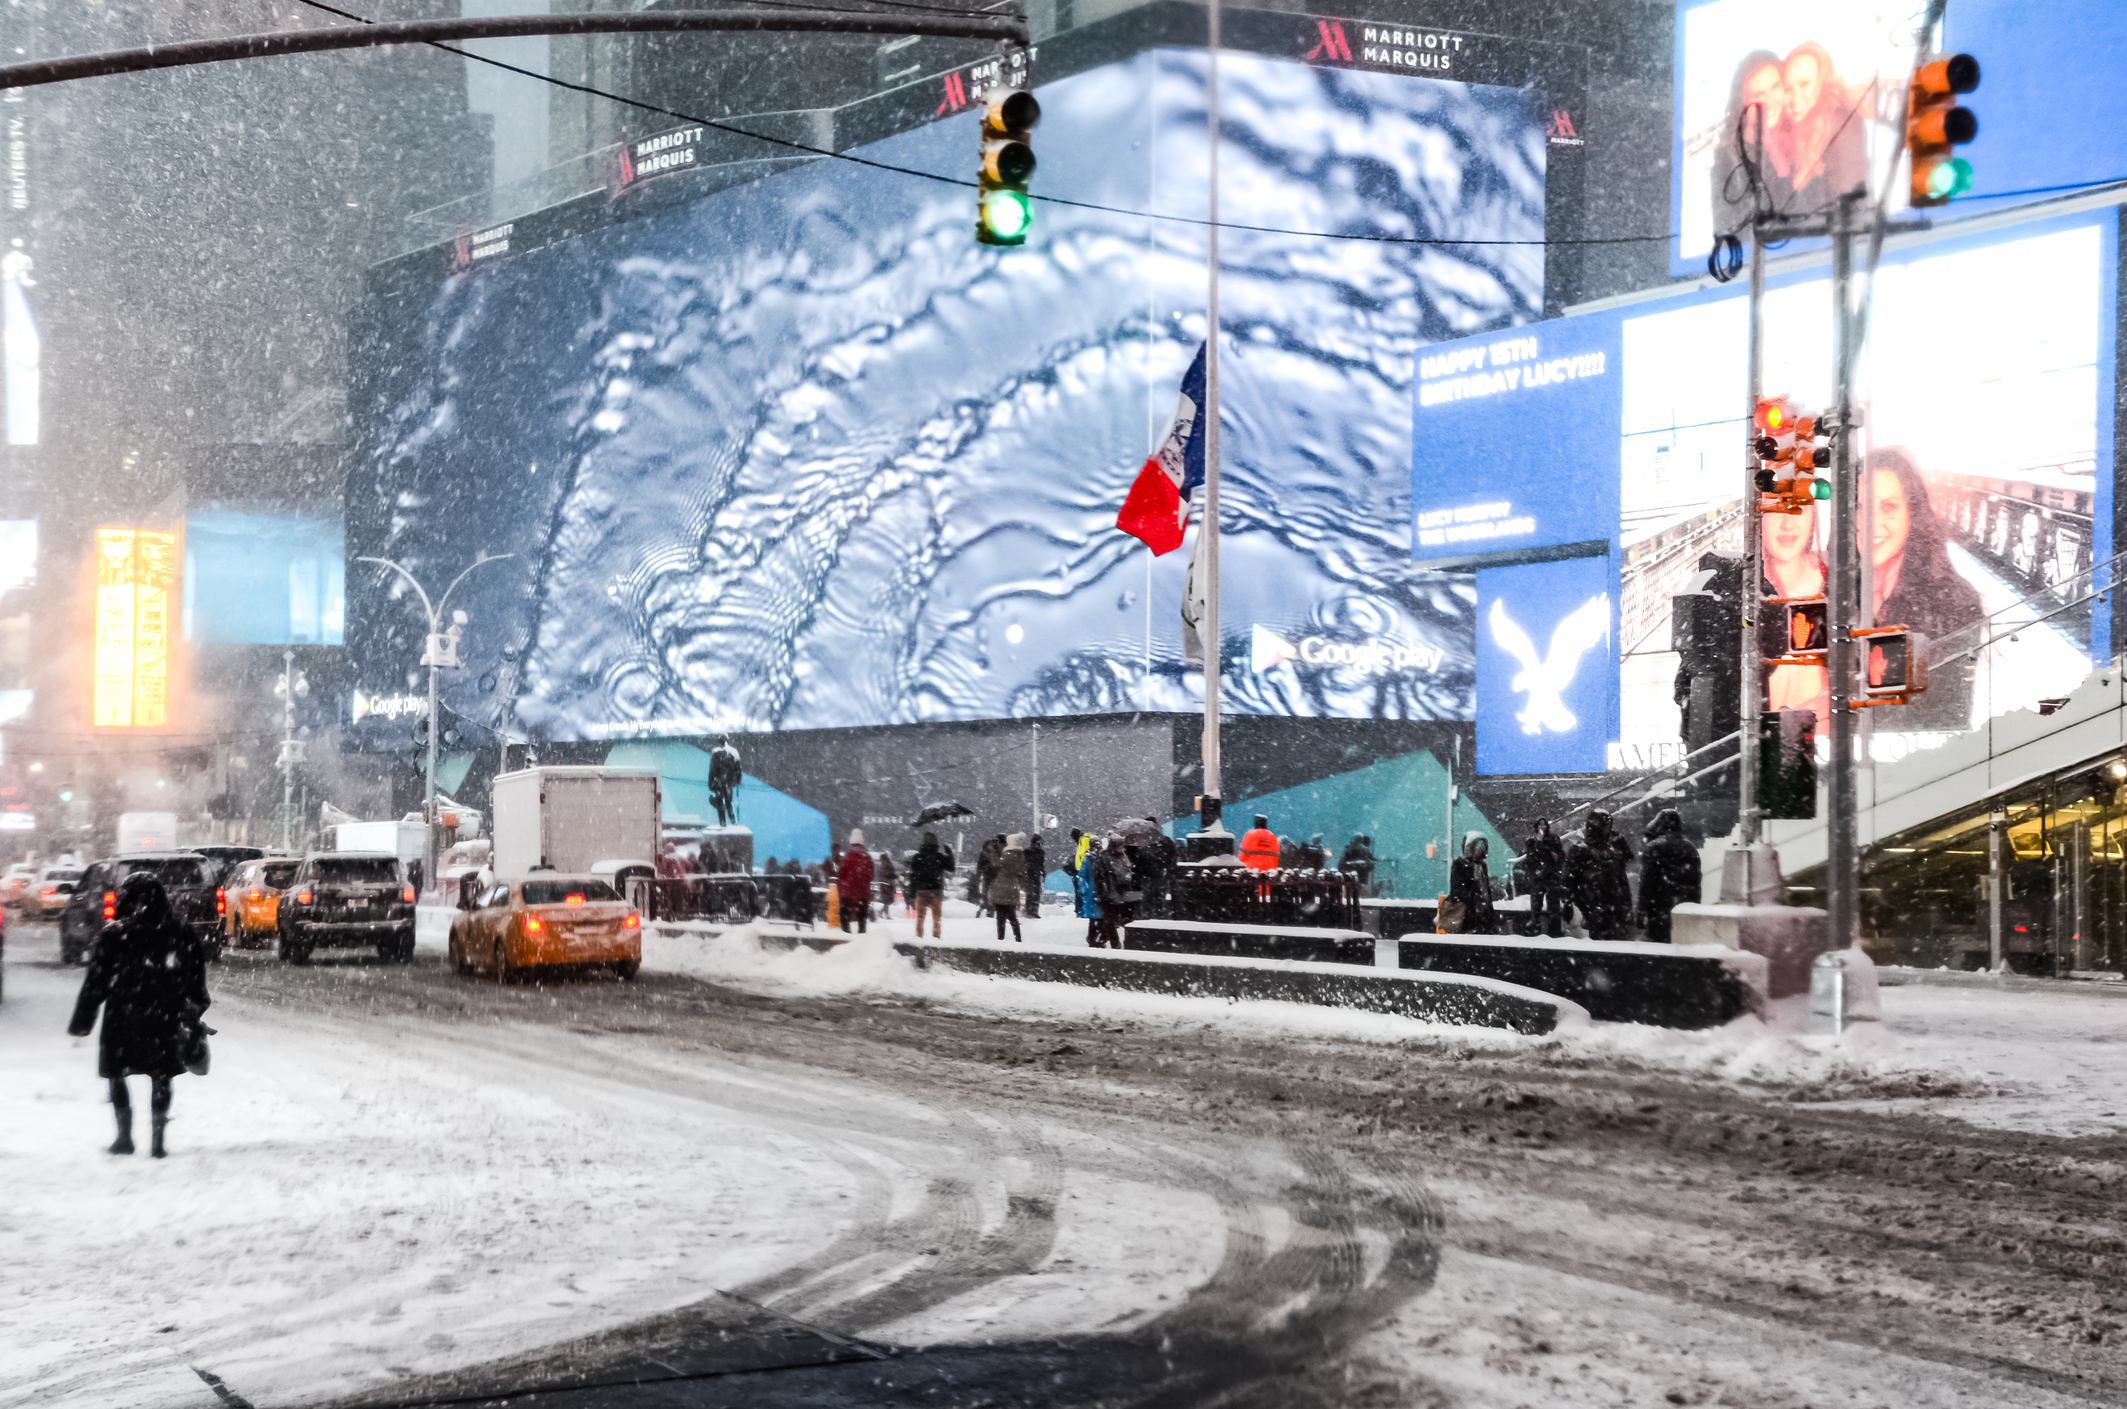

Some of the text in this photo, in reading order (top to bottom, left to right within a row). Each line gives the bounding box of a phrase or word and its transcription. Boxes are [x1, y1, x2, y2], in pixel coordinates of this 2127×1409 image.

[1364, 28, 1463, 51] MARRIOTT
[972, 47, 1038, 81] MAROT
[1364, 47, 1450, 69] MARQUIS
[637, 128, 703, 157] MARRIOTT
[1551, 137, 1584, 145] MARRIOTT
[637, 148, 694, 175] MARQUIS
[473, 224, 513, 245] MARRIOTT
[473, 240, 509, 259] MARQUIS
[1421, 337, 1537, 379] HAPPY 15TH
[1421, 352, 1605, 405] BIRTHDAY LUCY!!!!
[1418, 517, 1535, 545] THE WOODLANDS
[1300, 637, 1444, 674] Google play
[370, 692, 423, 720] Google play
